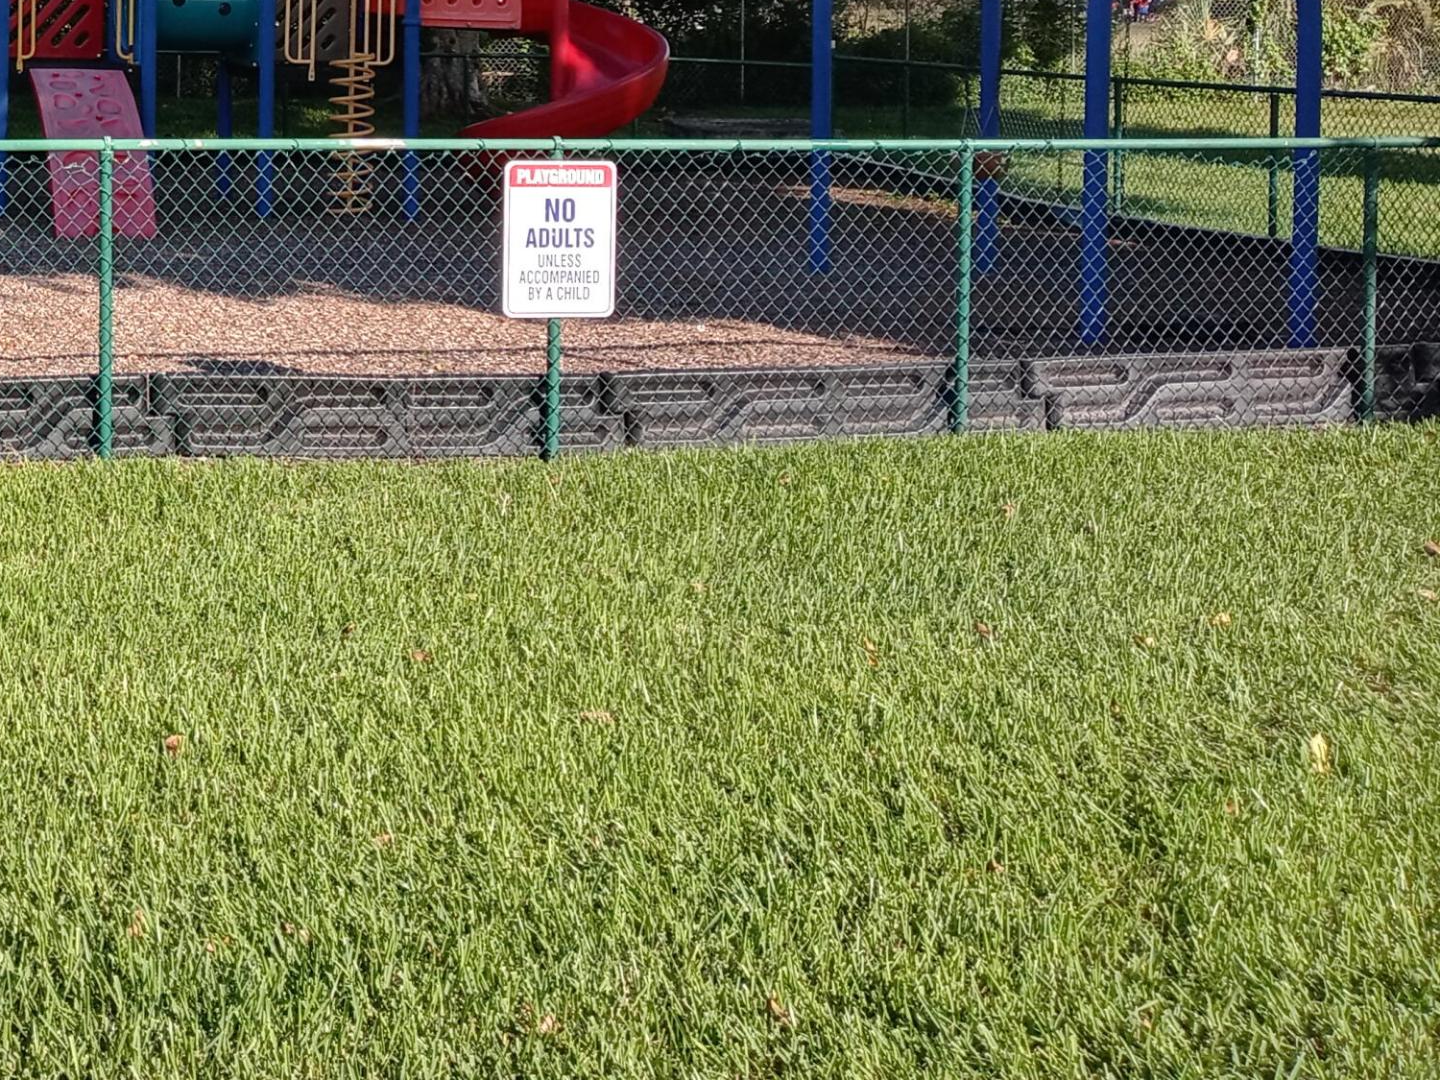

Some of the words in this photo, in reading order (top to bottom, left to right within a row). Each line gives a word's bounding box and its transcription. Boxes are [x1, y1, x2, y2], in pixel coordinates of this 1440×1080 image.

[517, 168, 605, 185] PLAYGROUND
[544, 198, 576, 222] NO
[525, 227, 595, 249] ADULTS
[538, 253, 582, 268] UNLESS
[519, 270, 600, 284] ACCOMPANIED
[528, 286, 542, 301] BY
[545, 286, 553, 301] A
[557, 287, 590, 301] CHILD
